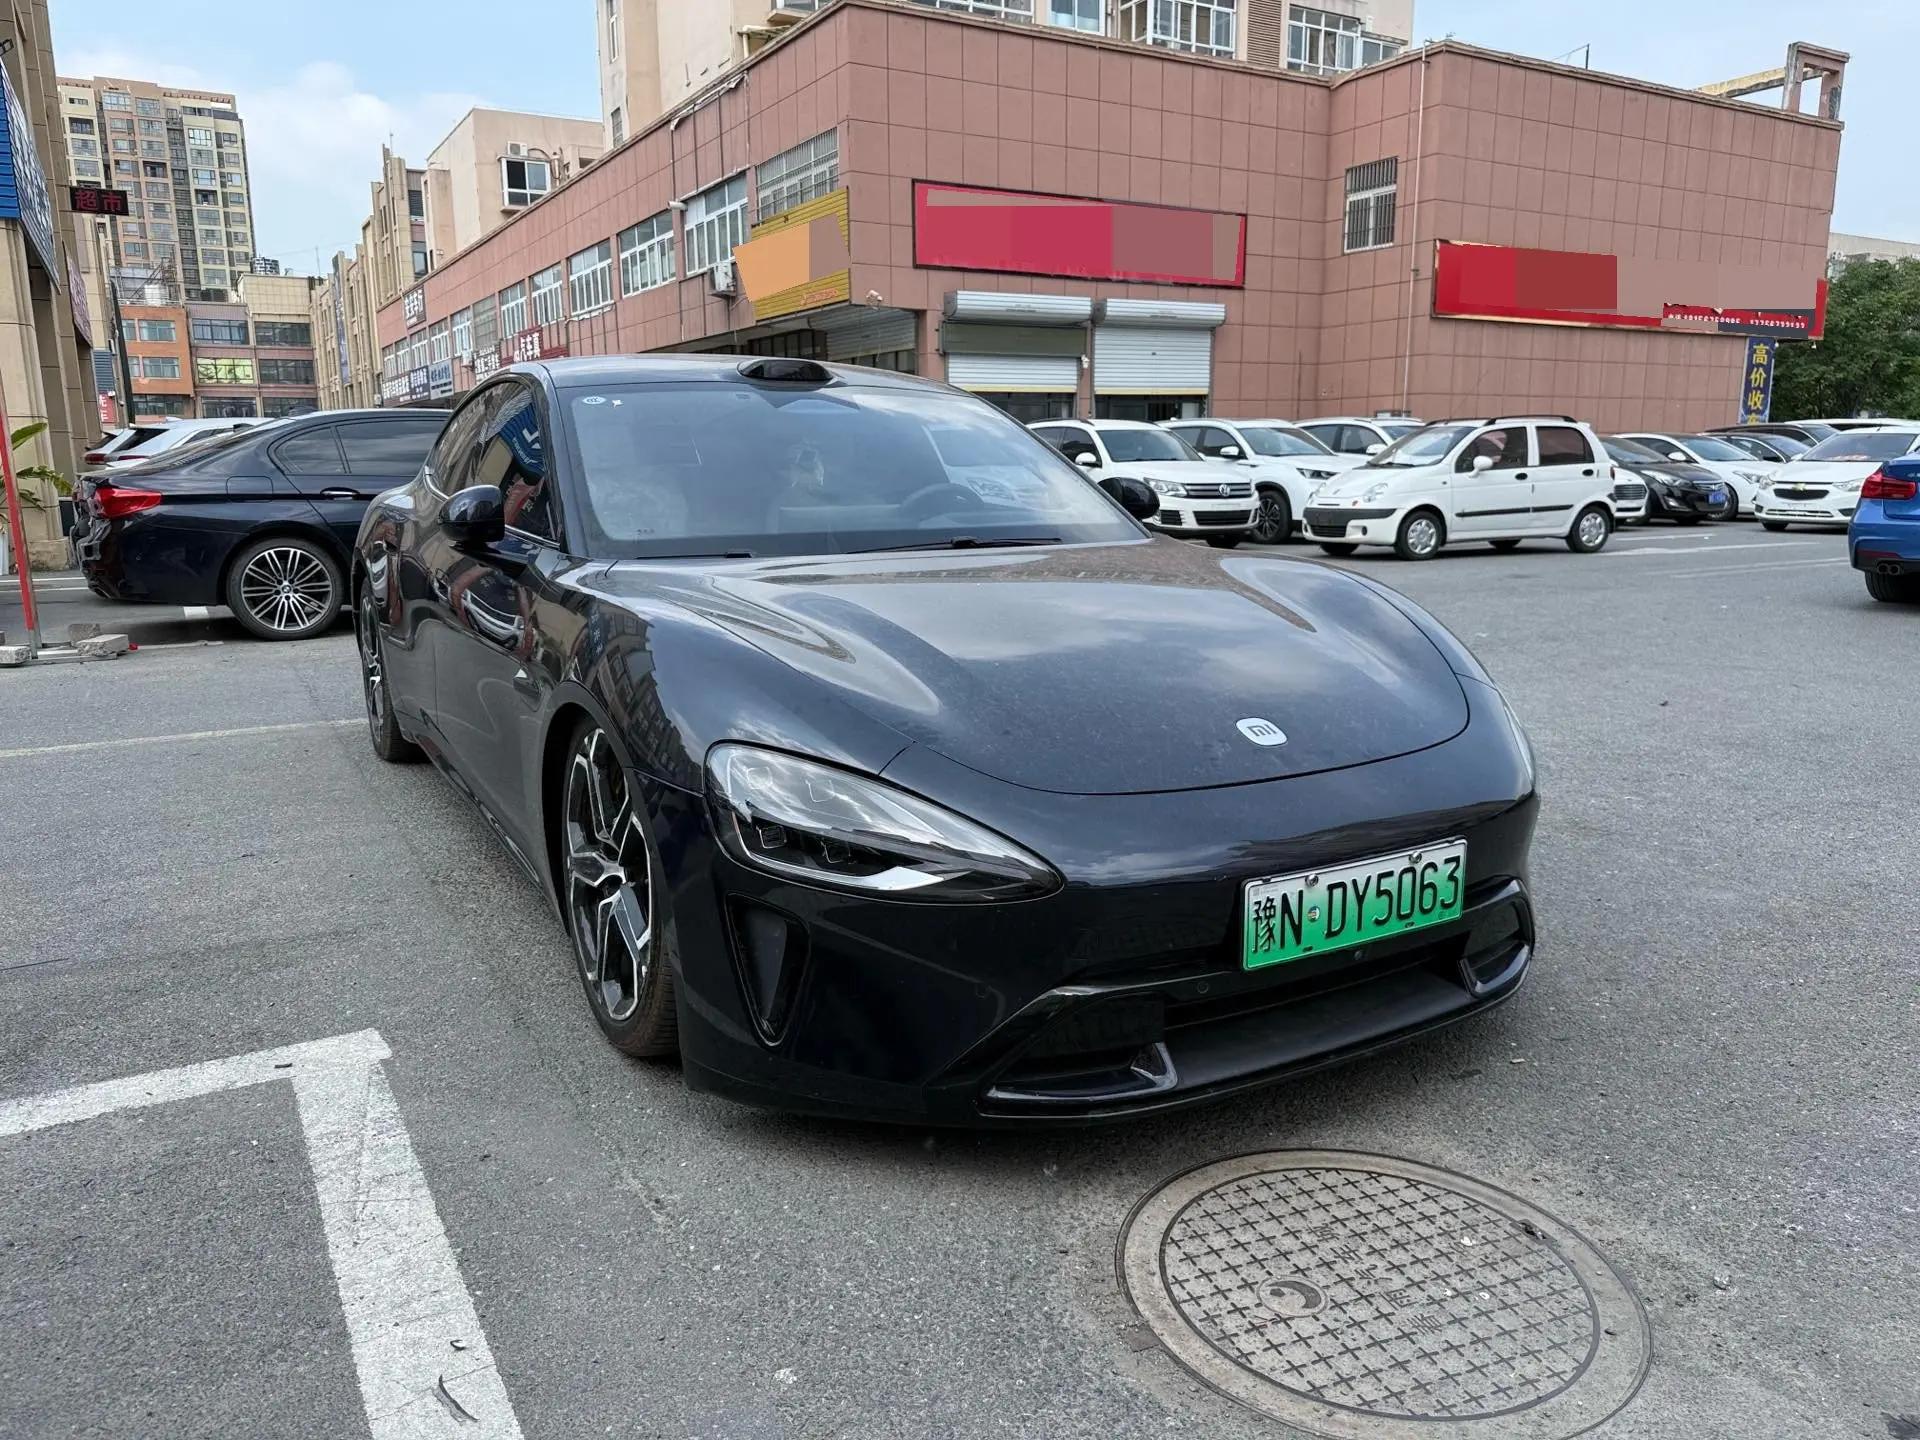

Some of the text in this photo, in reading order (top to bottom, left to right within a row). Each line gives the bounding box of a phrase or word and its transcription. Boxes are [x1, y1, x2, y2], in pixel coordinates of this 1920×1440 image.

[75, 190, 122, 211] 超市
[1252, 855, 1461, 954] 豫N DY5063
[1306, 1223, 1443, 1336] 春雨汽车城
